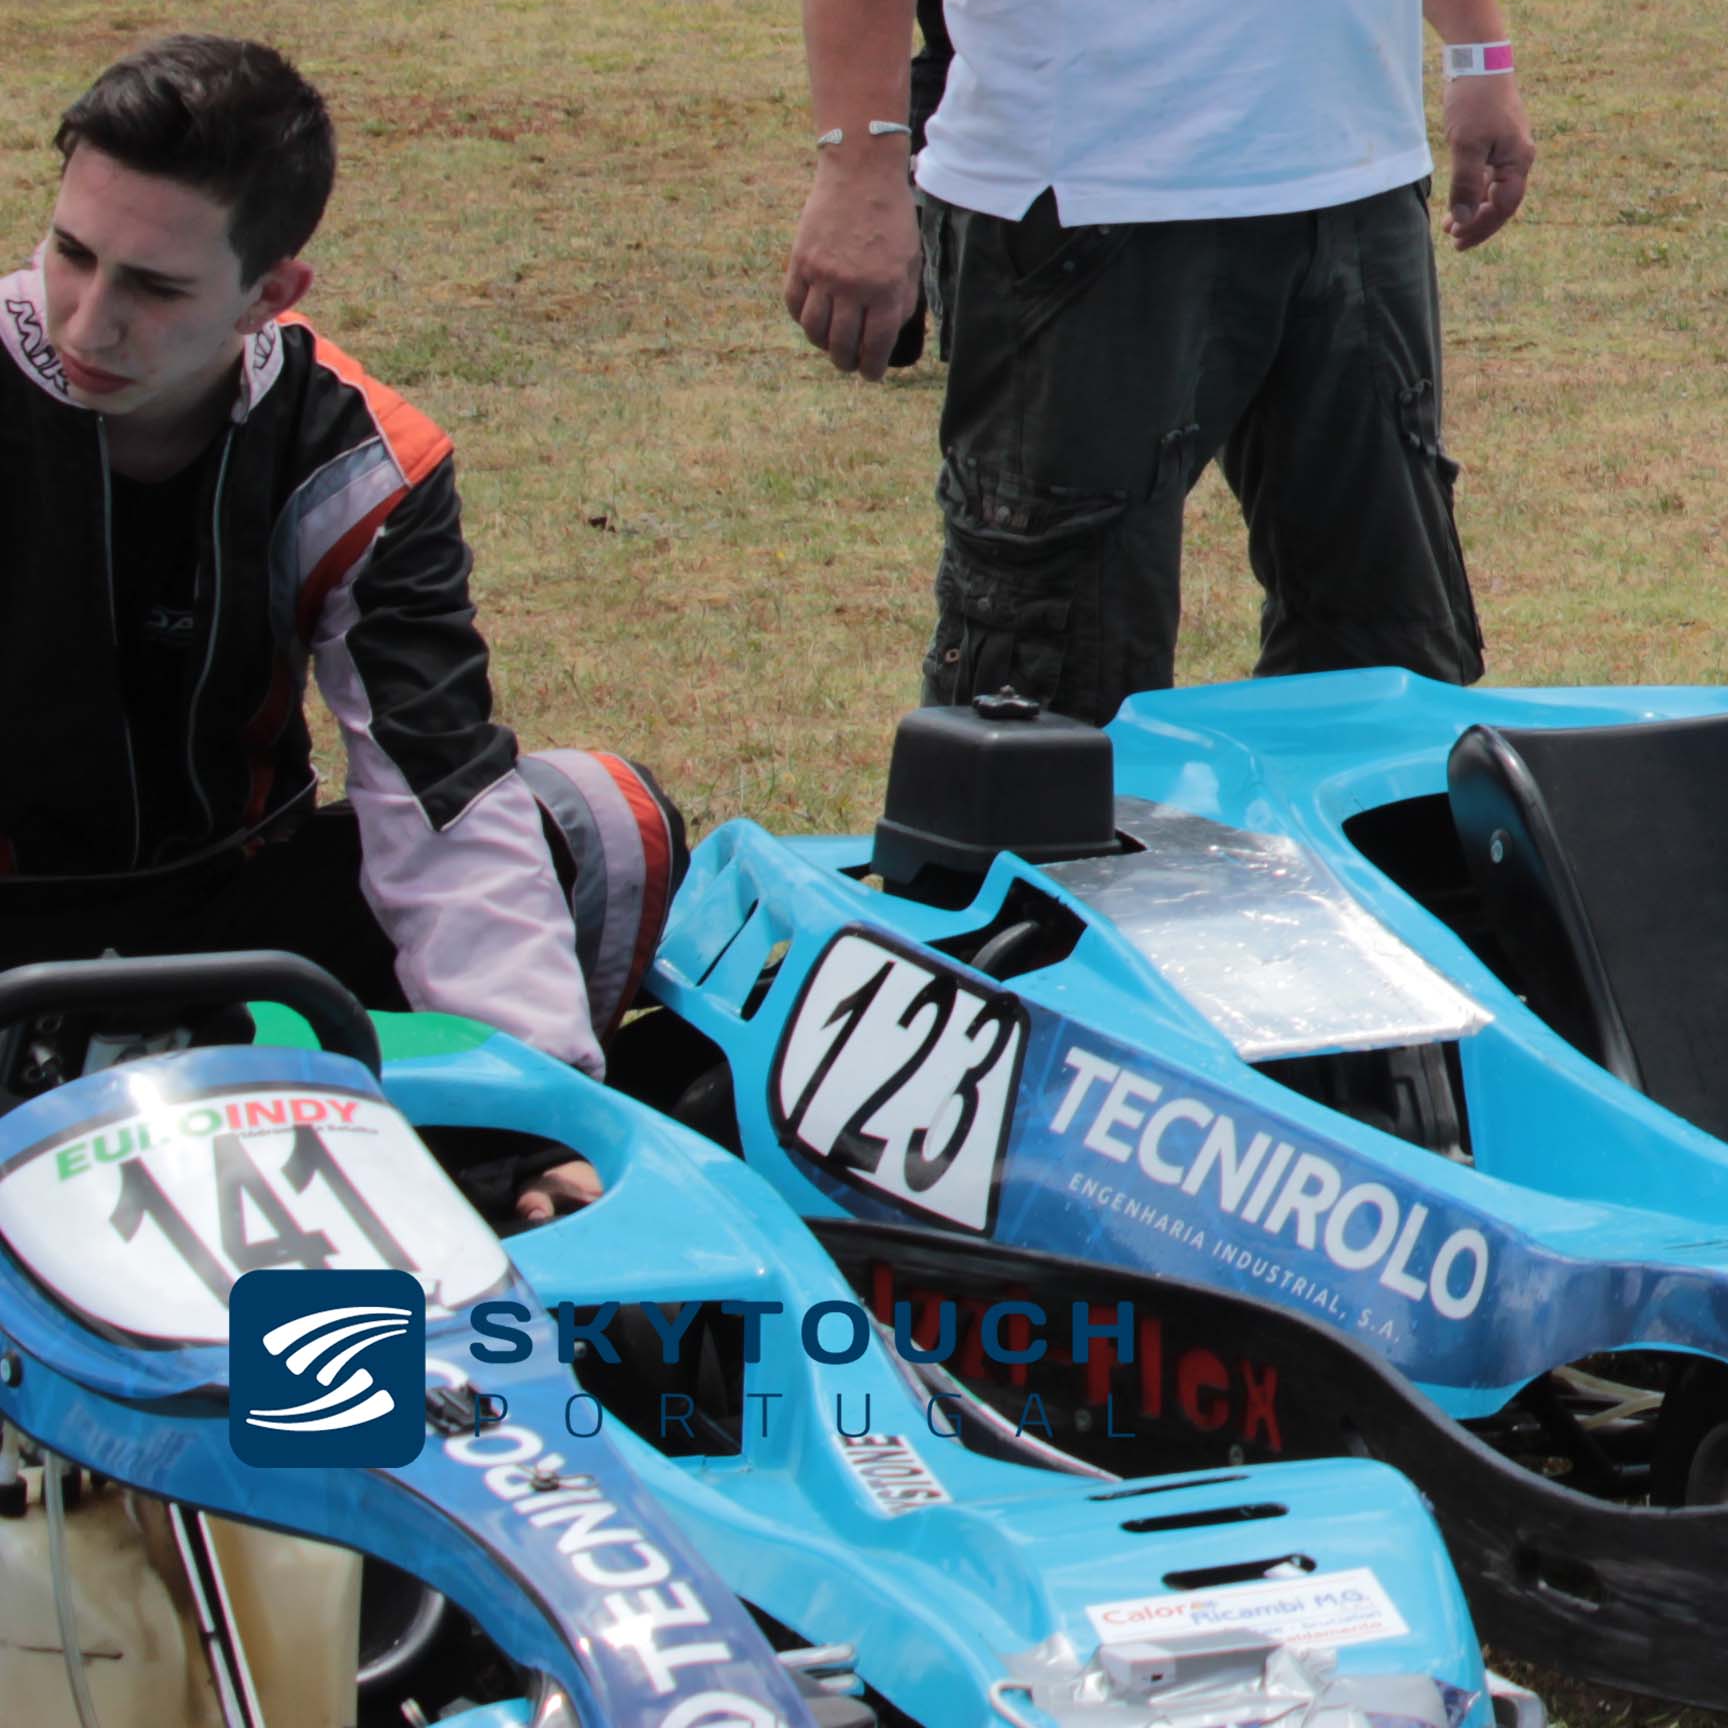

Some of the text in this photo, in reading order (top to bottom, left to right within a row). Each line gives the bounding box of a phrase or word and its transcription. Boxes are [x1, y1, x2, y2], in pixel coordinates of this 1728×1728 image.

[778, 960, 1021, 1193] 123
[108, 1124, 422, 1310] 141
[1048, 1045, 1489, 1321] TECNIROLO
[1068, 1171, 1206, 1250] ENGENHARIA
